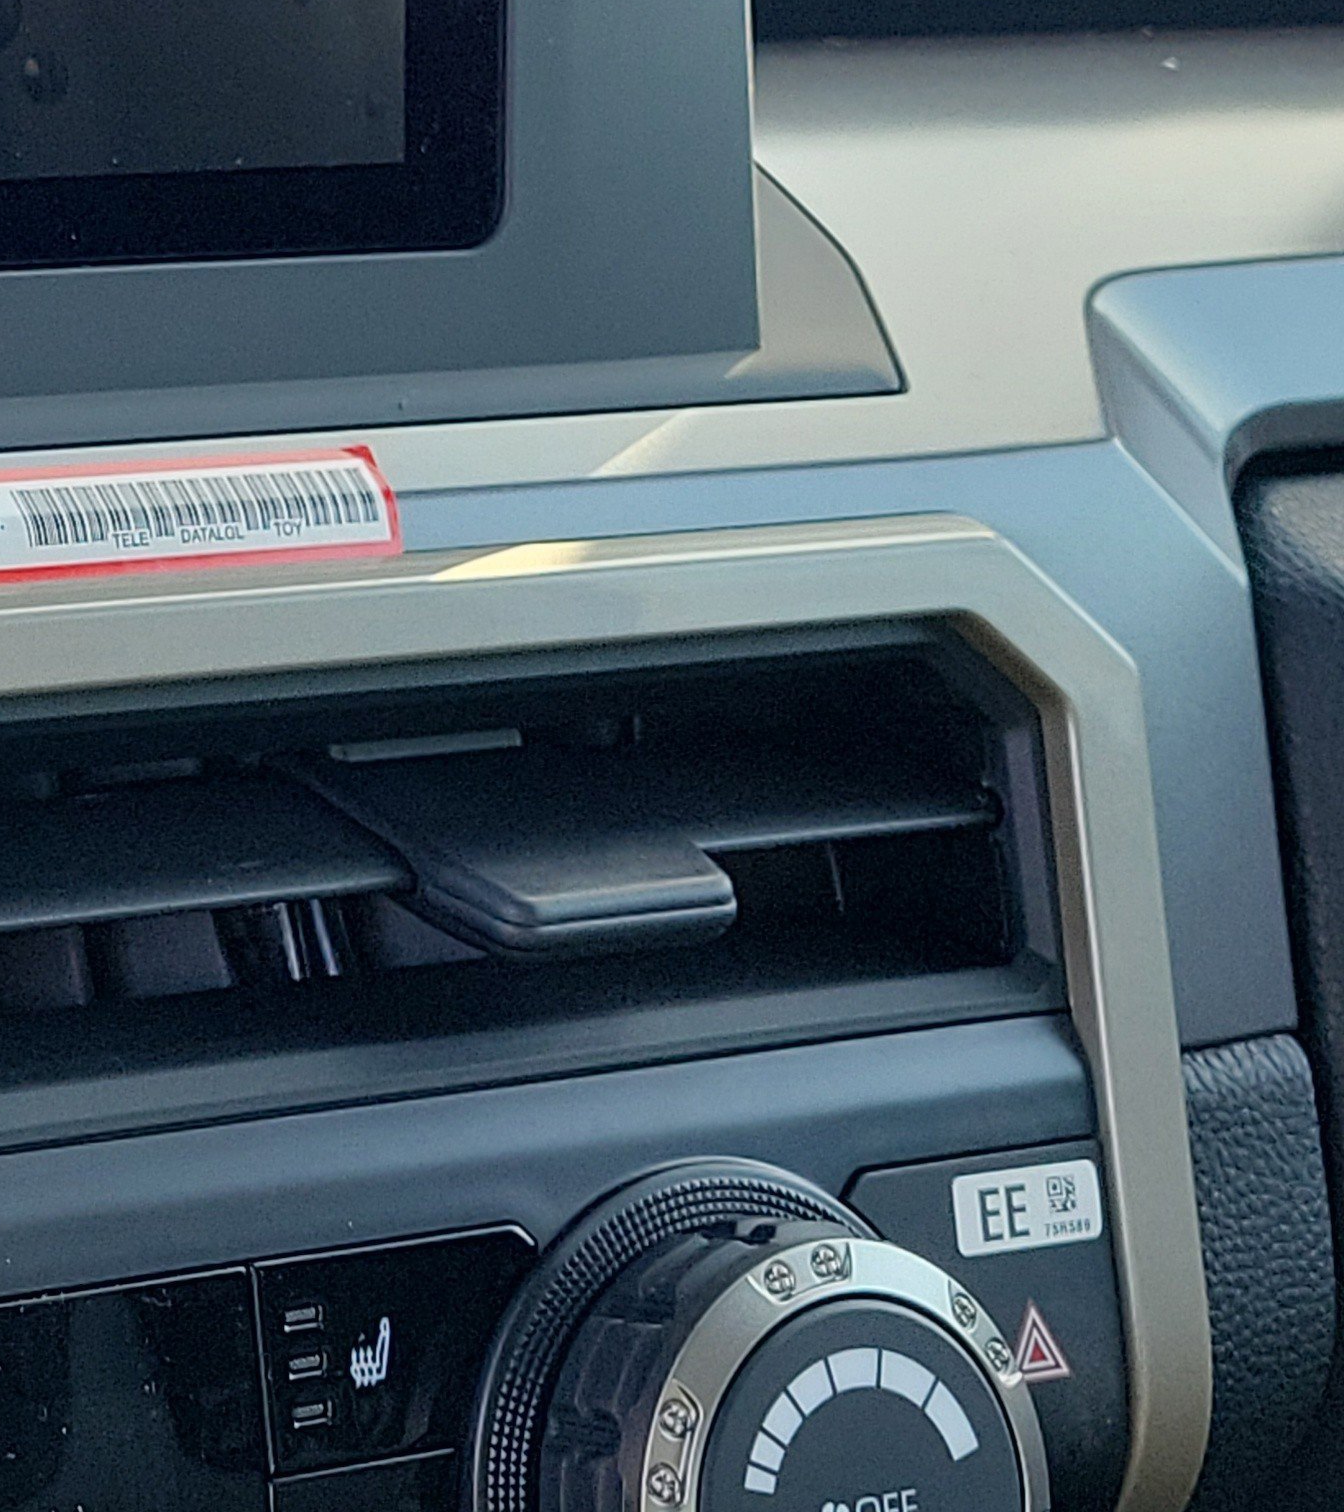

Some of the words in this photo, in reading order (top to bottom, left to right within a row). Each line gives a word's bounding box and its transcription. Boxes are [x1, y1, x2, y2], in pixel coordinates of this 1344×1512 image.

[113, 531, 150, 549] TELE
[274, 520, 302, 537] TOY
[978, 1183, 1030, 1243] EE
[855, 1488, 918, 1512] OFF
